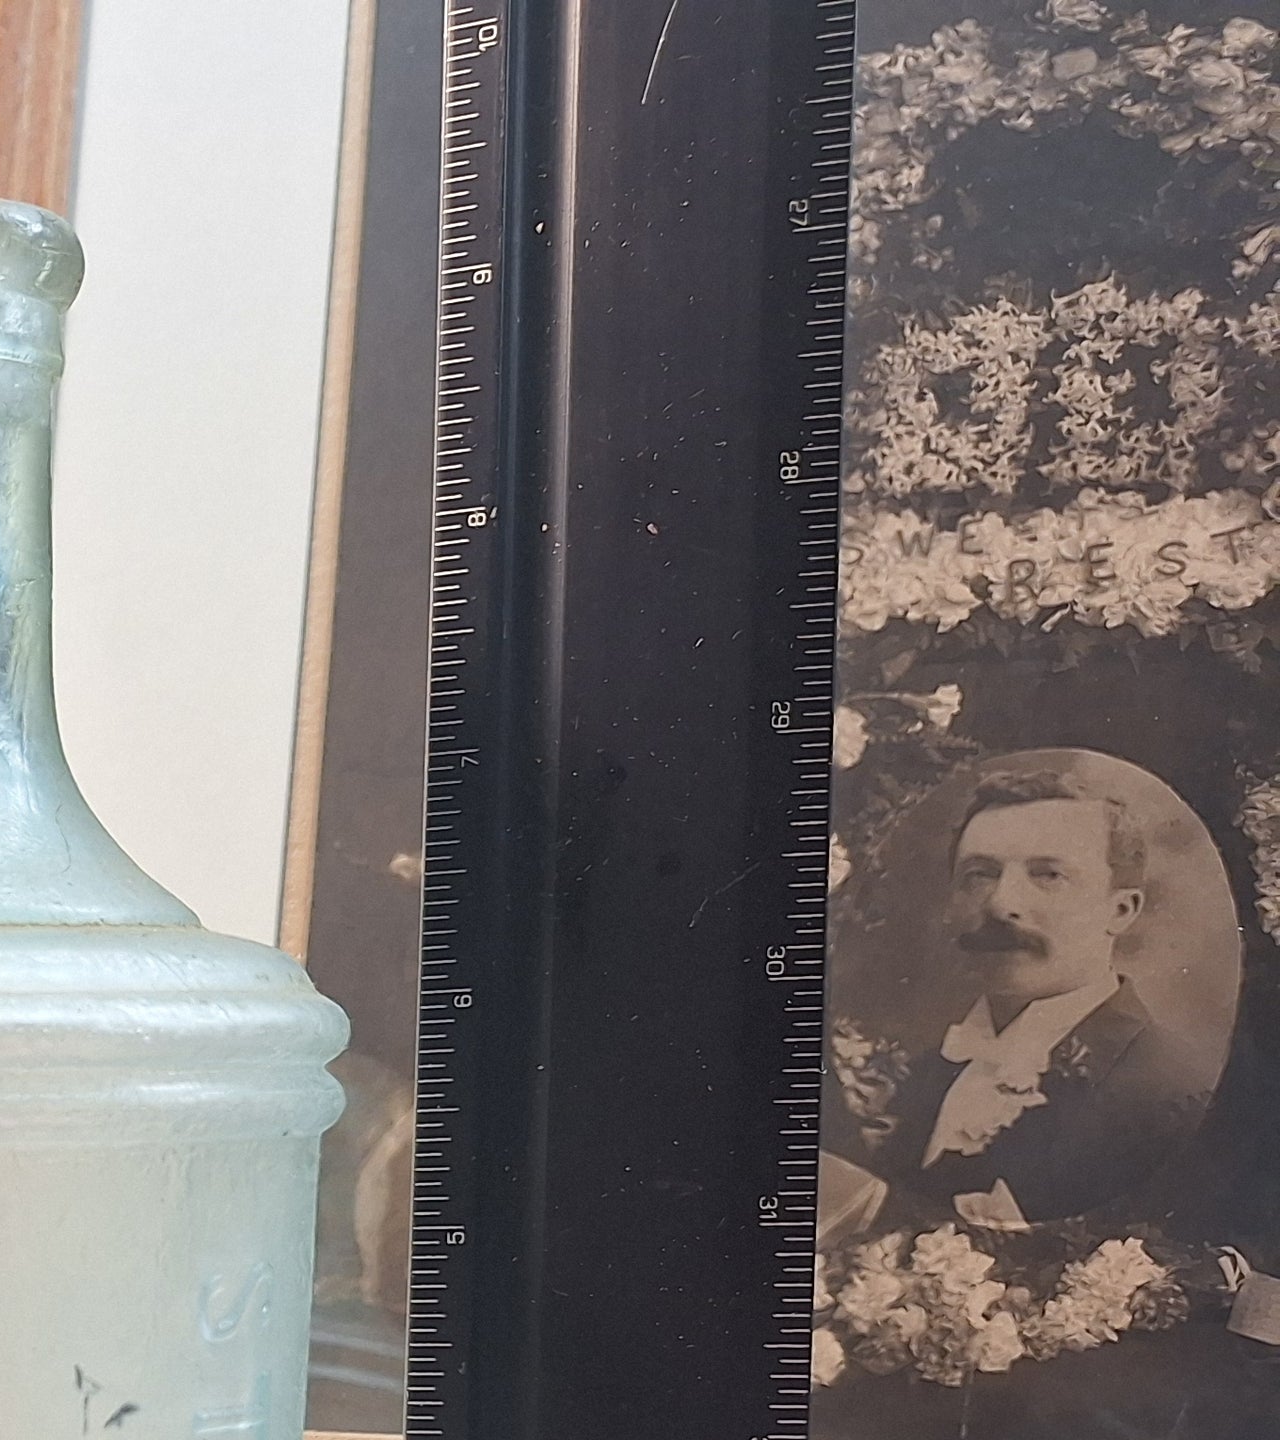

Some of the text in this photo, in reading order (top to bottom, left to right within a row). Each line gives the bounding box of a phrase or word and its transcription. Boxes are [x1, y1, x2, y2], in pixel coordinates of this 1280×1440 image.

[478, 23, 498, 53] 10
[789, 198, 809, 228] 27
[473, 269, 493, 285] 9
[779, 450, 800, 481] 28
[468, 511, 487, 528] 8
[770, 699, 790, 730] 29
[461, 754, 480, 769] 7
[765, 945, 785, 977] 30
[453, 994, 472, 1009] 6
[758, 1195, 778, 1222] 31
[446, 1230, 465, 1245] 5
